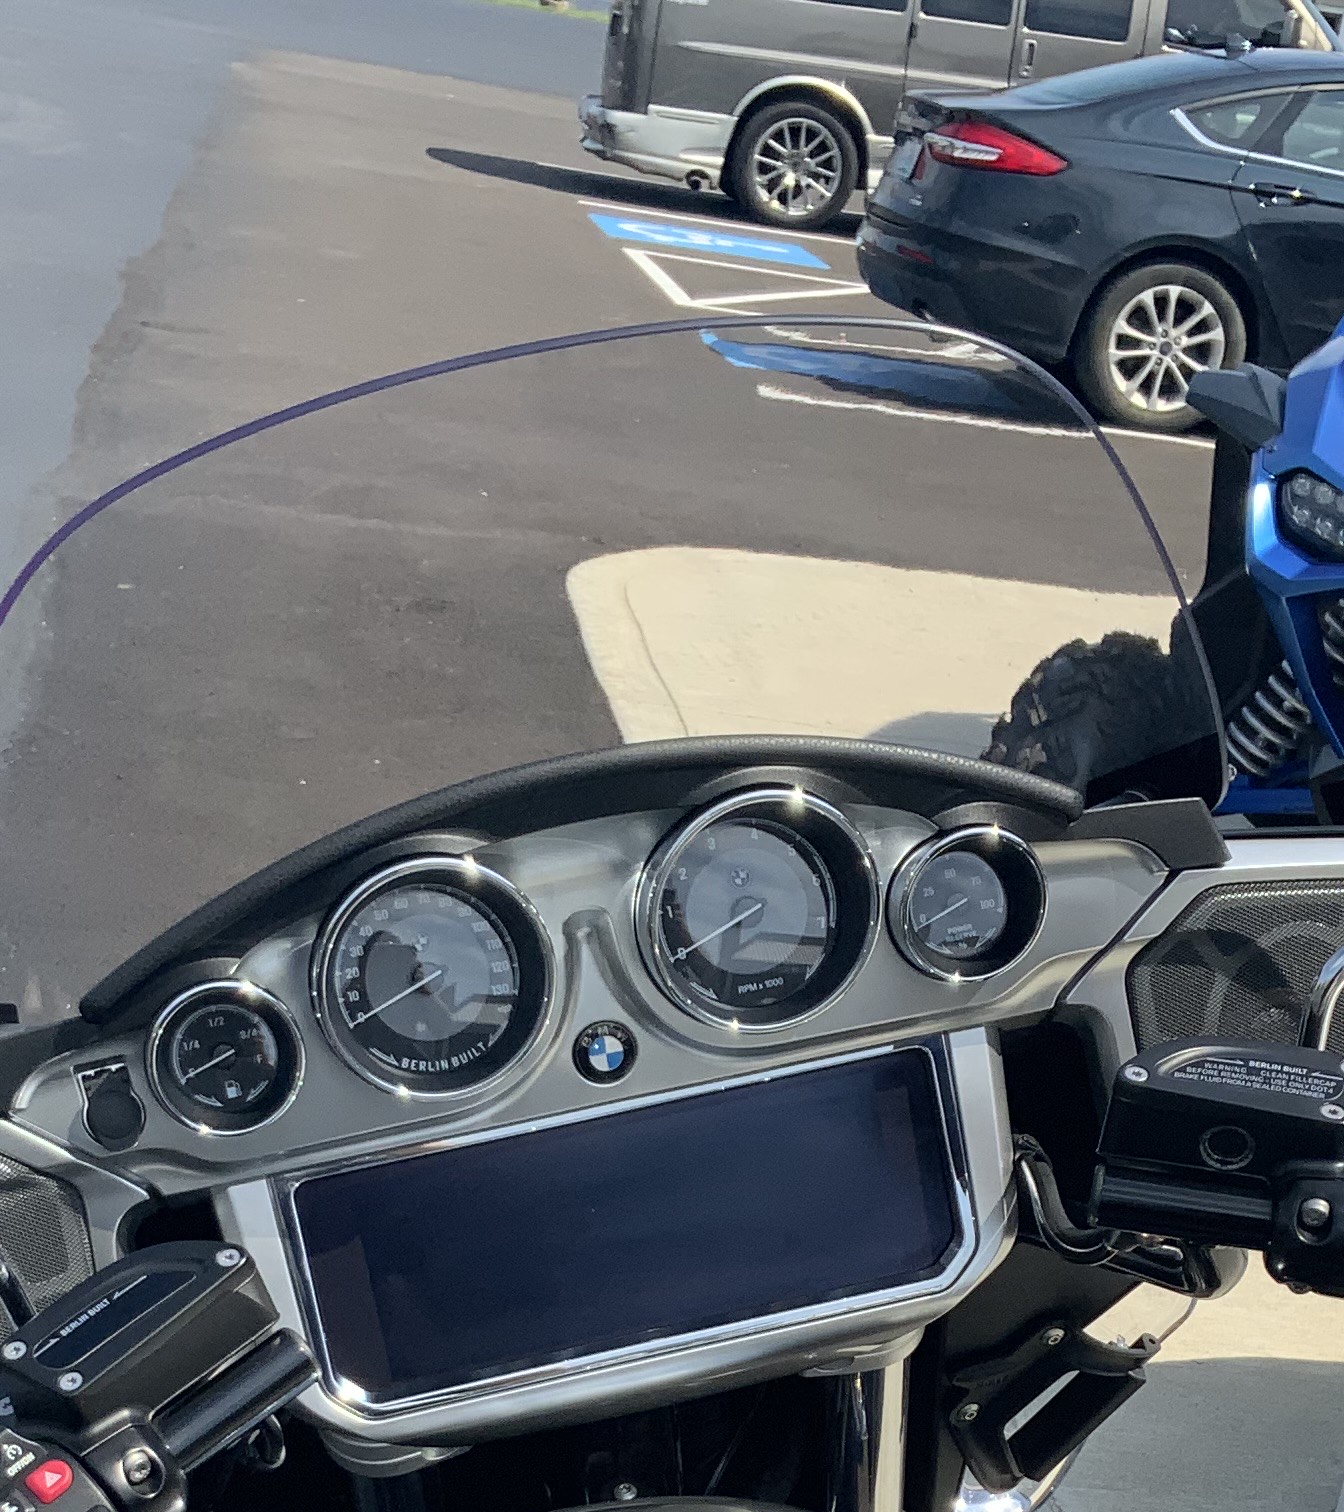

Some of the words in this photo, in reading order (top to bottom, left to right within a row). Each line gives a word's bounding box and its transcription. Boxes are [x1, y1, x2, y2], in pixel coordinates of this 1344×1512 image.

[751, 828, 758, 840] 4
[707, 837, 716, 850] 3
[679, 867, 688, 880] 2
[812, 874, 821, 887] 6
[980, 898, 995, 910] 100
[666, 905, 673, 919] 1
[359, 925, 374, 937] 40
[349, 945, 364, 958] 30
[345, 966, 360, 979] 20
[738, 983, 757, 994] RPM
[765, 977, 784, 988] 1000
[347, 990, 360, 1003] 10
[208, 1016, 225, 1028] 1/2
[182, 1039, 201, 1052] 1/4
[401, 1057, 449, 1072] BERLIN
[451, 1041, 487, 1067] BUILT
[1204, 1062, 1248, 1073] WARNING
[1260, 1070, 1289, 1080] CLEAN
[1248, 1060, 1282, 1071] BERLIN
[1283, 1065, 1308, 1075] BUILT
[1186, 1066, 1219, 1077] BEFORE
[1270, 1078, 1288, 1087] USE
[59, 1313, 90, 1337] BERLIN
[87, 1298, 111, 1317] BUILT
